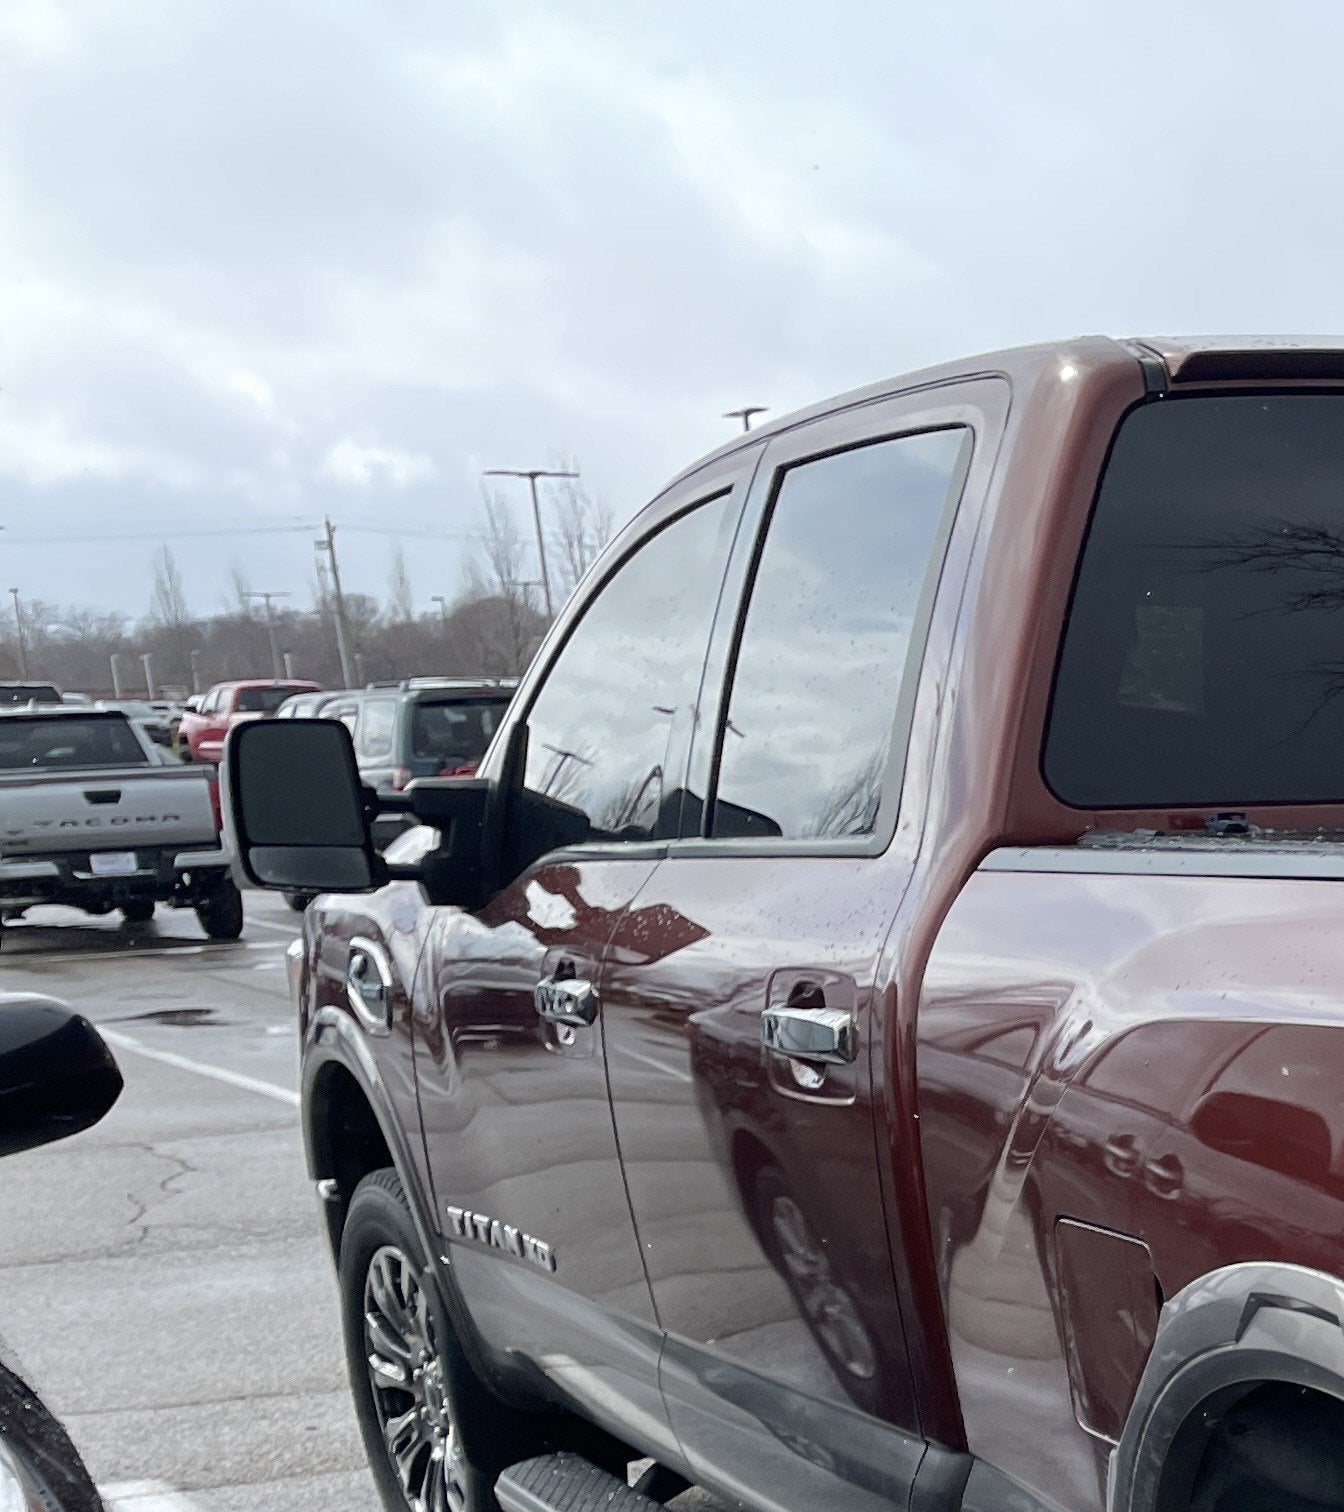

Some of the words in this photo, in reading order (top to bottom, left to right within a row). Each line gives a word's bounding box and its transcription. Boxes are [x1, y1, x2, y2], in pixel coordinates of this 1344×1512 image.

[33, 813, 181, 828] TACOMA
[446, 1206, 521, 1257] TITAN
[521, 1233, 552, 1271] XD
